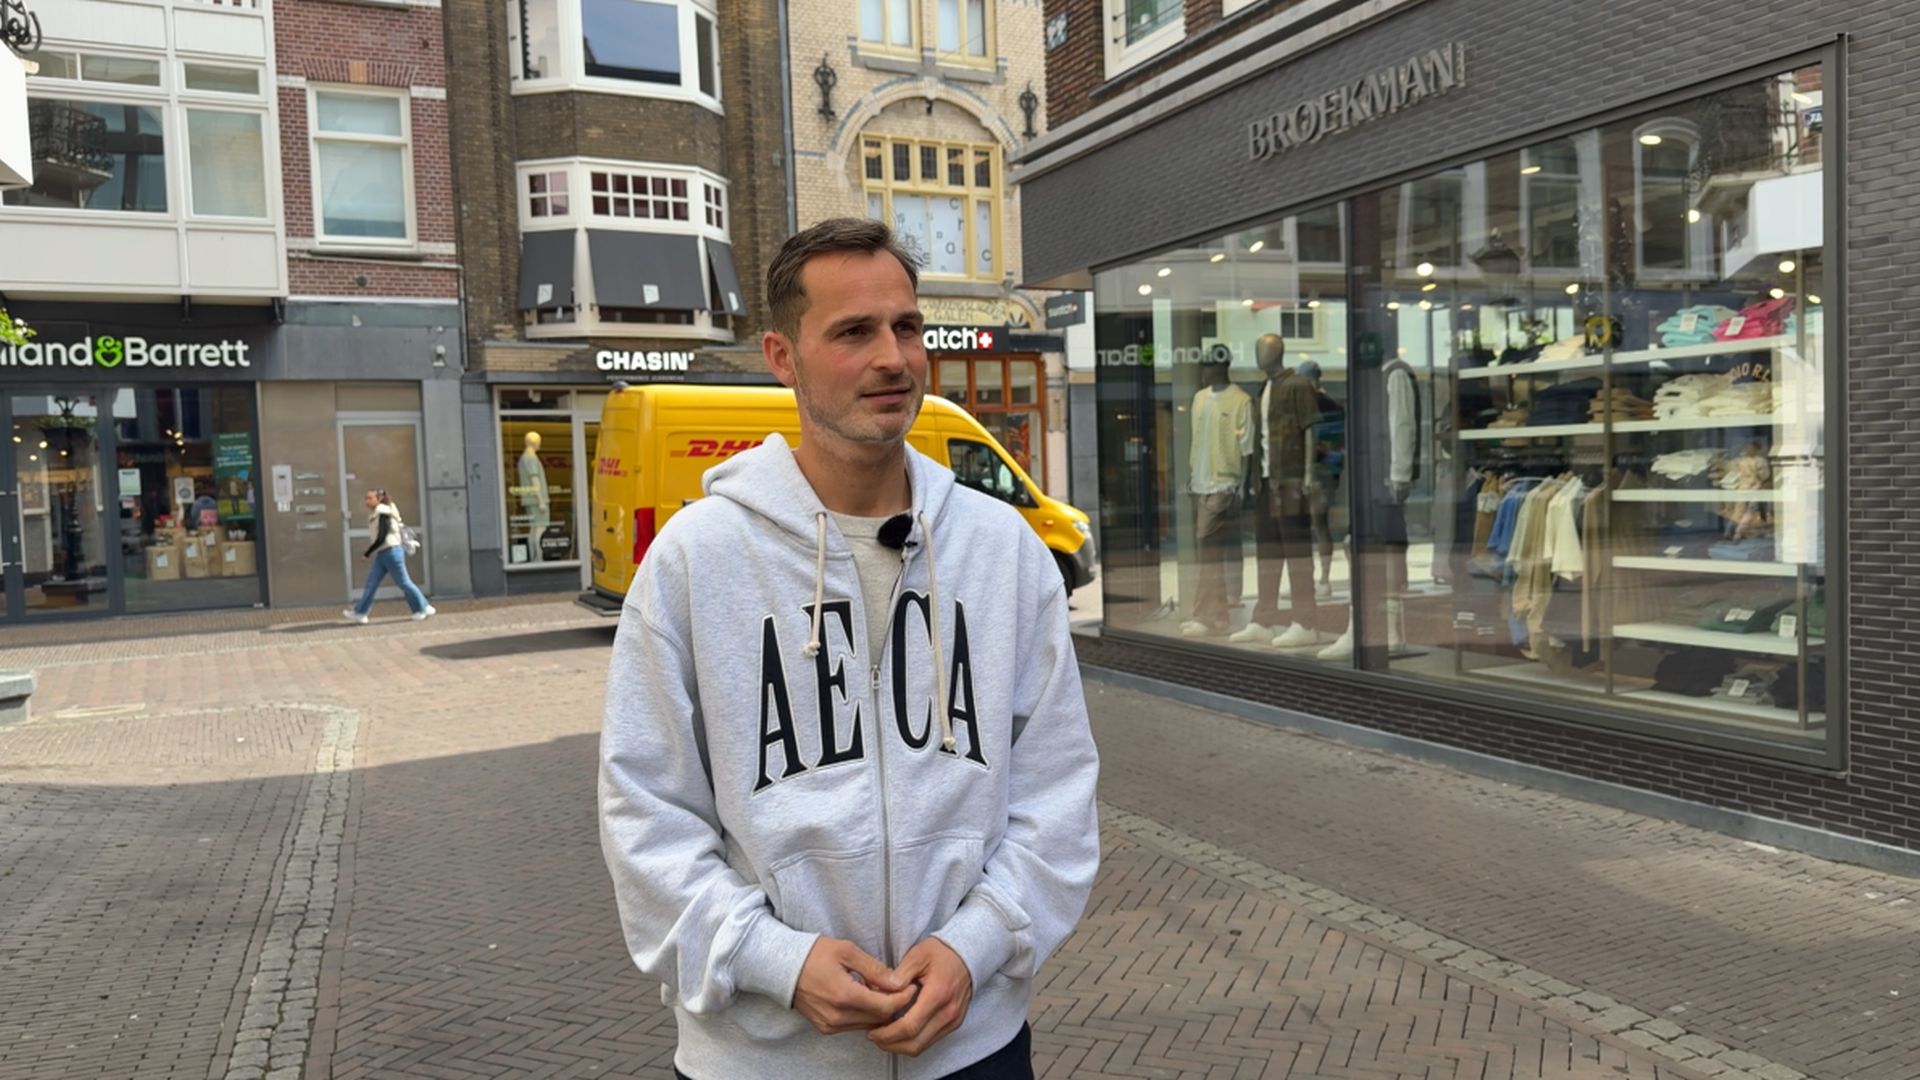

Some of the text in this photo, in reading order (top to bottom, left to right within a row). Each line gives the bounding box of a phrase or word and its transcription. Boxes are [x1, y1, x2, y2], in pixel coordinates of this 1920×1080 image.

[1247, 41, 1467, 160] BROEKMAN
[923, 327, 978, 350] atch
[596, 350, 695, 371] CHASIN'
